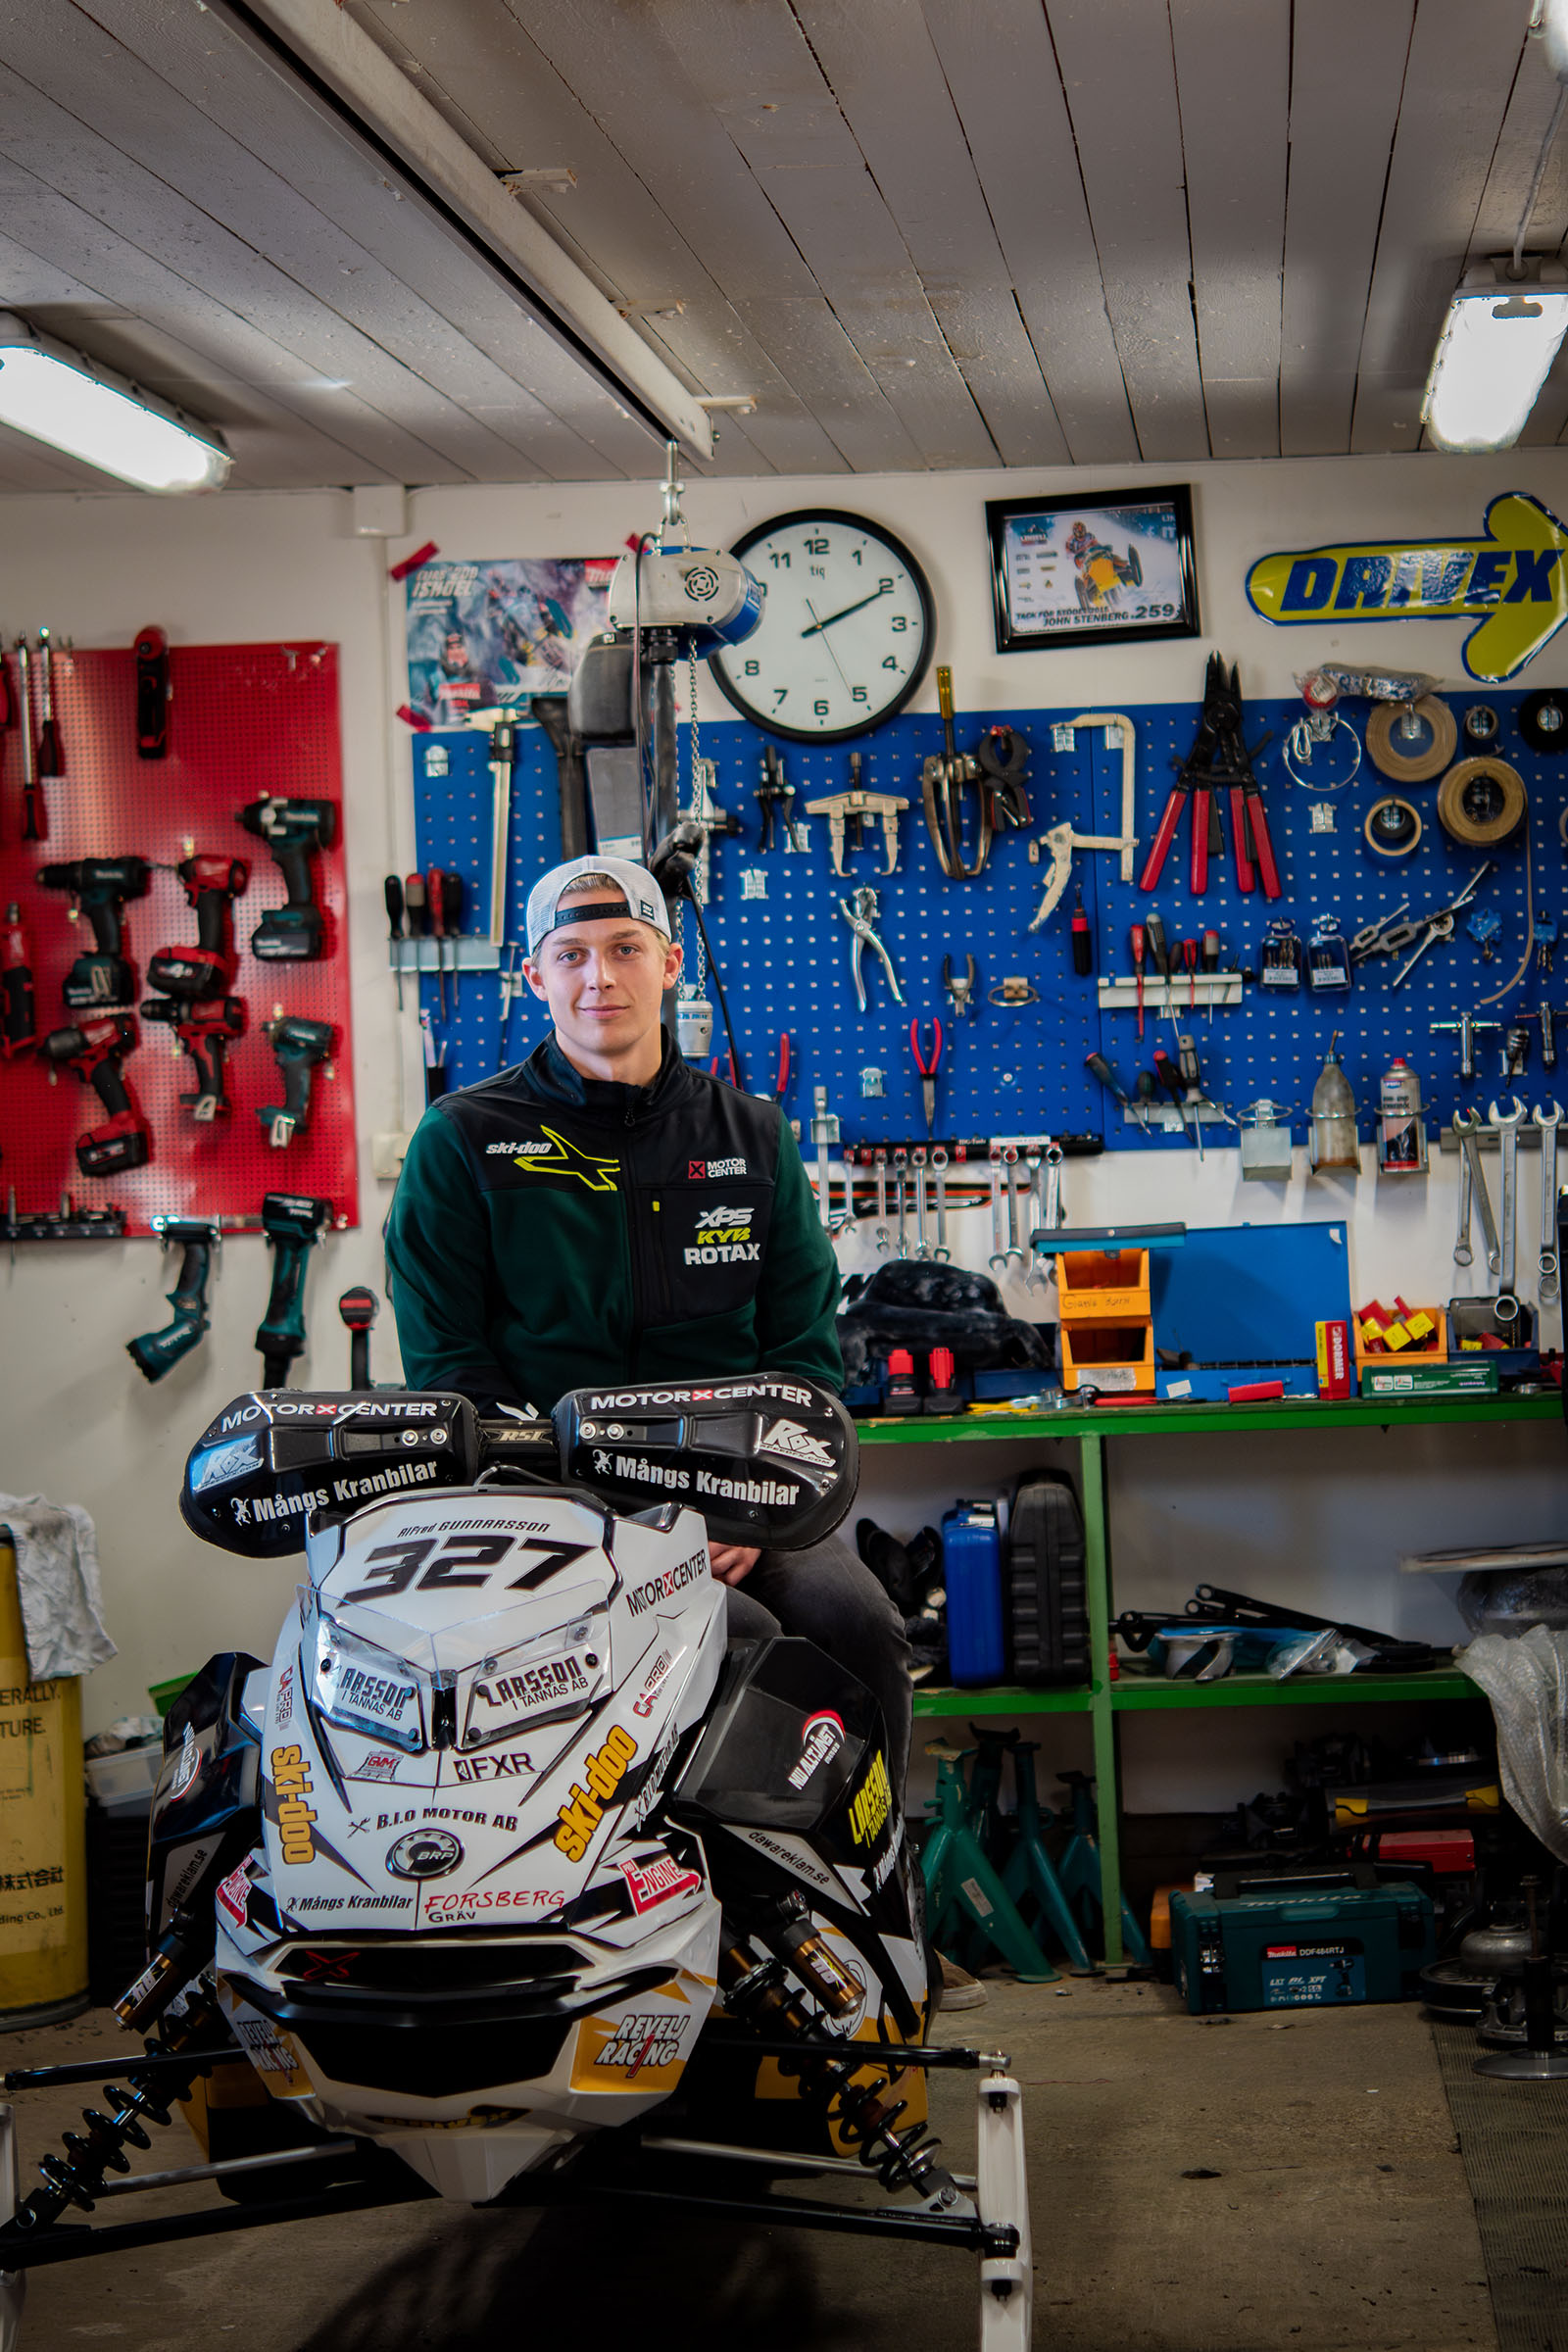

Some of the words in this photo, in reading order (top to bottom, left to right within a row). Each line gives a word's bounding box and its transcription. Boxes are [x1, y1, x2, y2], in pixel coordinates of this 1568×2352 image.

[803, 539, 830, 555] 12
[769, 552, 791, 568] 11
[852, 550, 862, 565] 1
[810, 565, 826, 580] tiq
[1280, 549, 1565, 612] DRIVEX
[879, 578, 894, 594] 2
[892, 616, 906, 632] 3
[1044, 615, 1071, 626] JOHN
[1074, 612, 1128, 624] STENBERG
[745, 661, 760, 676] 8
[882, 656, 899, 670] 4
[773, 689, 788, 705] 7
[852, 687, 867, 702] 5
[813, 700, 829, 715] 6
[486, 1141, 553, 1154] ski-doo
[708, 1158, 746, 1170] MOTOR
[708, 1166, 748, 1179] CENTER
[697, 1227, 752, 1245] KYB
[684, 1243, 760, 1265] ROTAX
[1333, 1337, 1345, 1380] DORMER
[615, 1456, 690, 1489] Mångs
[696, 1471, 800, 1506] Kranbilar
[253, 1489, 329, 1522] Mångs
[333, 1461, 438, 1501] Kranbilar
[336, 1536, 598, 1609] 327
[339, 1667, 407, 1709] ARSSON
[487, 1655, 582, 1707] LARSSON
[518, 1682, 569, 1707] TÄNNÄS
[571, 1677, 589, 1693] AB
[348, 1691, 386, 1716] TÄNNÄS
[385, 1707, 404, 1722] AB
[470, 1752, 535, 1779] FXR
[554, 1725, 638, 1862] ski-doo
[270, 1744, 318, 1865] ski-doo
[376, 1810, 416, 1831] B.I.O
[421, 1807, 487, 1825] MOTOR
[492, 1814, 518, 1833] AB
[416, 1851, 455, 1860] BRP
[749, 1831, 830, 1886] dawareklam.se
[299, 1895, 344, 1911] Mångs
[348, 1894, 414, 1910] Kranbilar
[424, 1890, 565, 1914] FORSBERG
[616, 2015, 690, 2044] REVELJ
[595, 2040, 680, 2068] RACING
